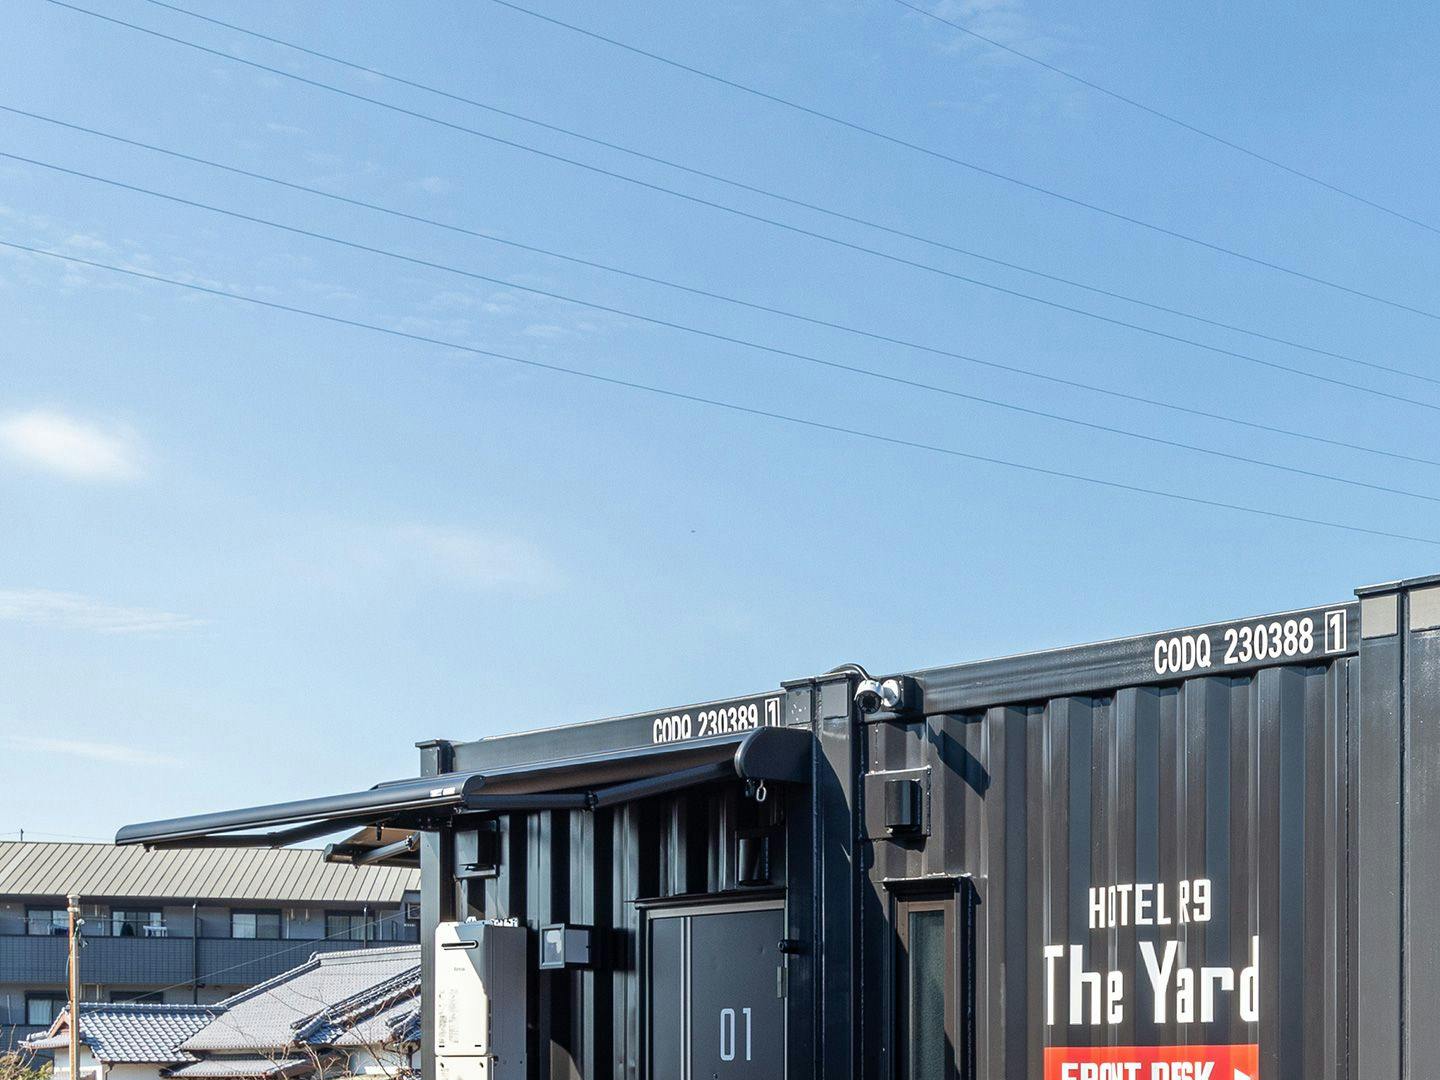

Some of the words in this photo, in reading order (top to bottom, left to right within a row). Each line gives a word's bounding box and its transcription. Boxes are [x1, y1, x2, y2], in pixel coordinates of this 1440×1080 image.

[1153, 633, 1212, 675] CODQ
[1224, 617, 1314, 664] 230388
[1327, 611, 1343, 652] 1
[698, 703, 759, 737] 230389
[1088, 882, 1172, 929] HOTEL
[1179, 878, 1212, 924] R9
[1043, 943, 1124, 1026] The
[1138, 935, 1259, 1024] Yard
[720, 1007, 752, 1061] 01
